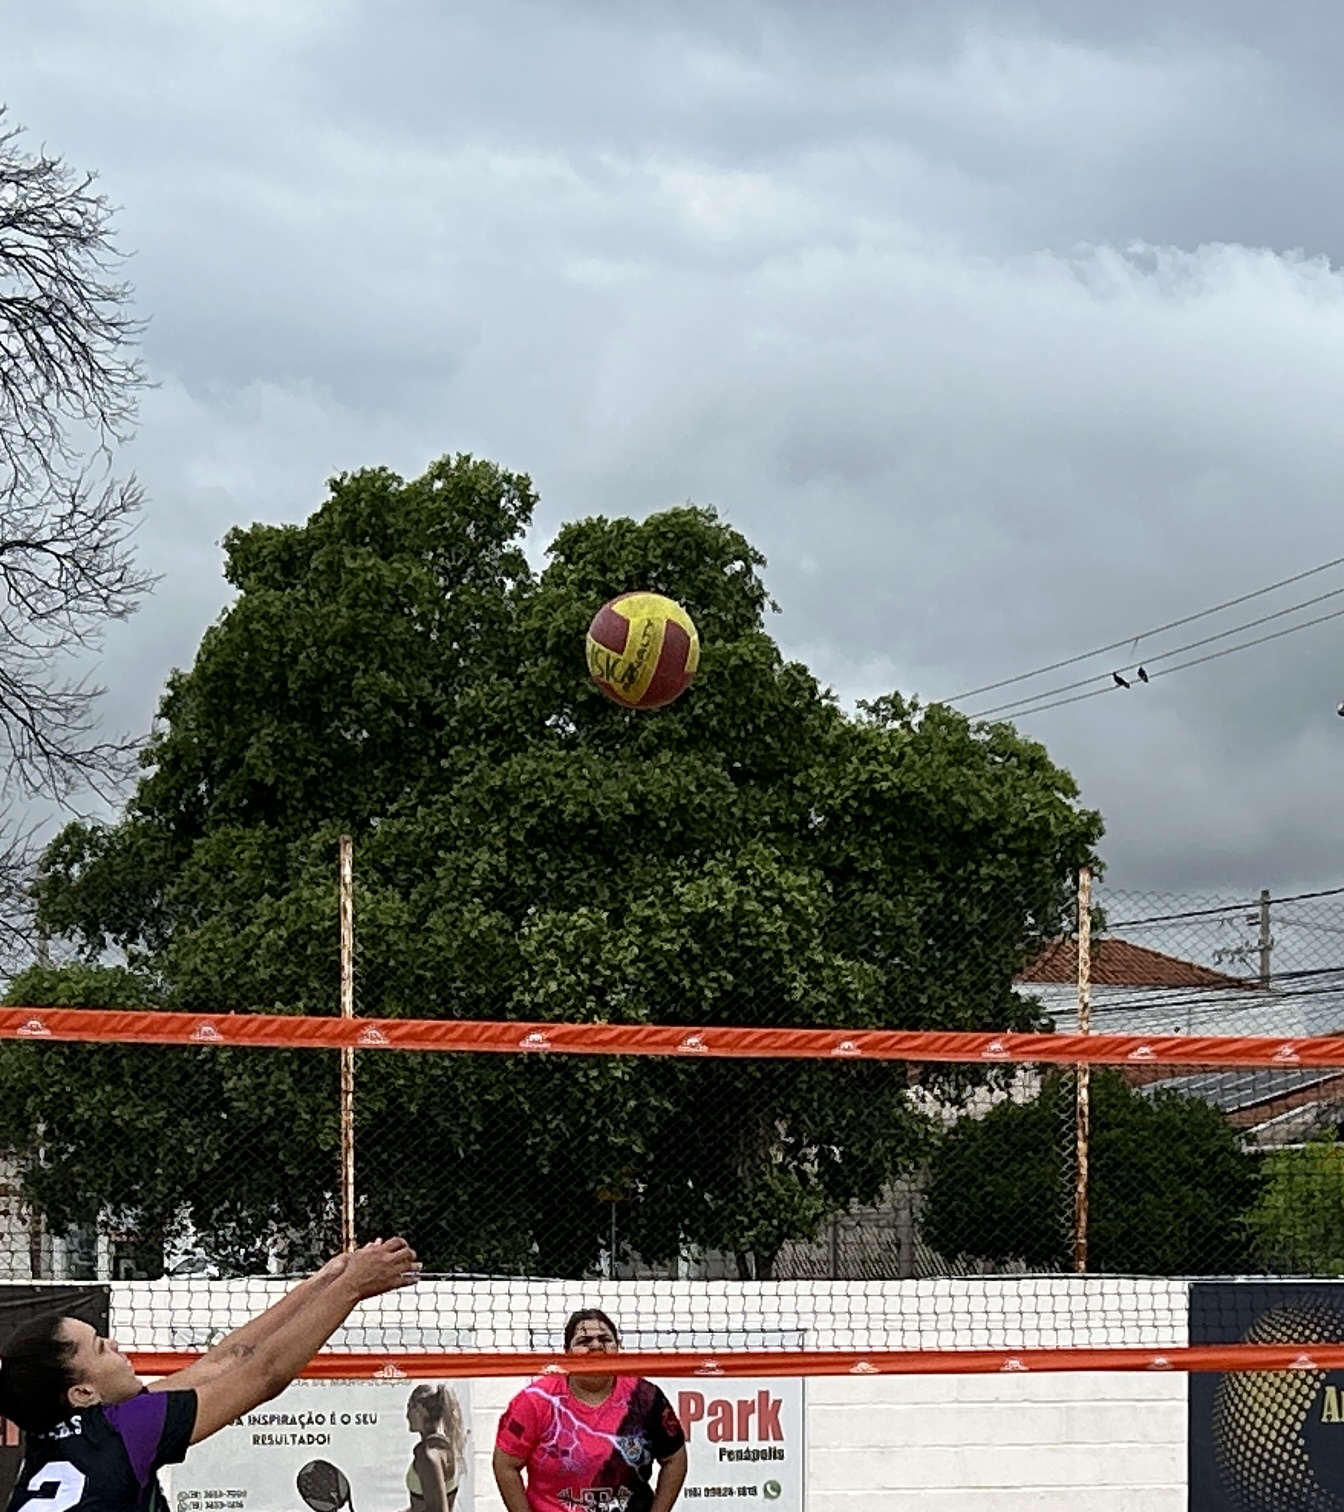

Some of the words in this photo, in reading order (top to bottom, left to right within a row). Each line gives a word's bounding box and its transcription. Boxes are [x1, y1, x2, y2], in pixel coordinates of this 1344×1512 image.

[247, 1410, 326, 1429] INSPIRAÇÃO
[329, 1410, 337, 1426] É
[340, 1414, 352, 1426] O
[354, 1412, 379, 1426] SEU
[677, 1388, 786, 1444] Park
